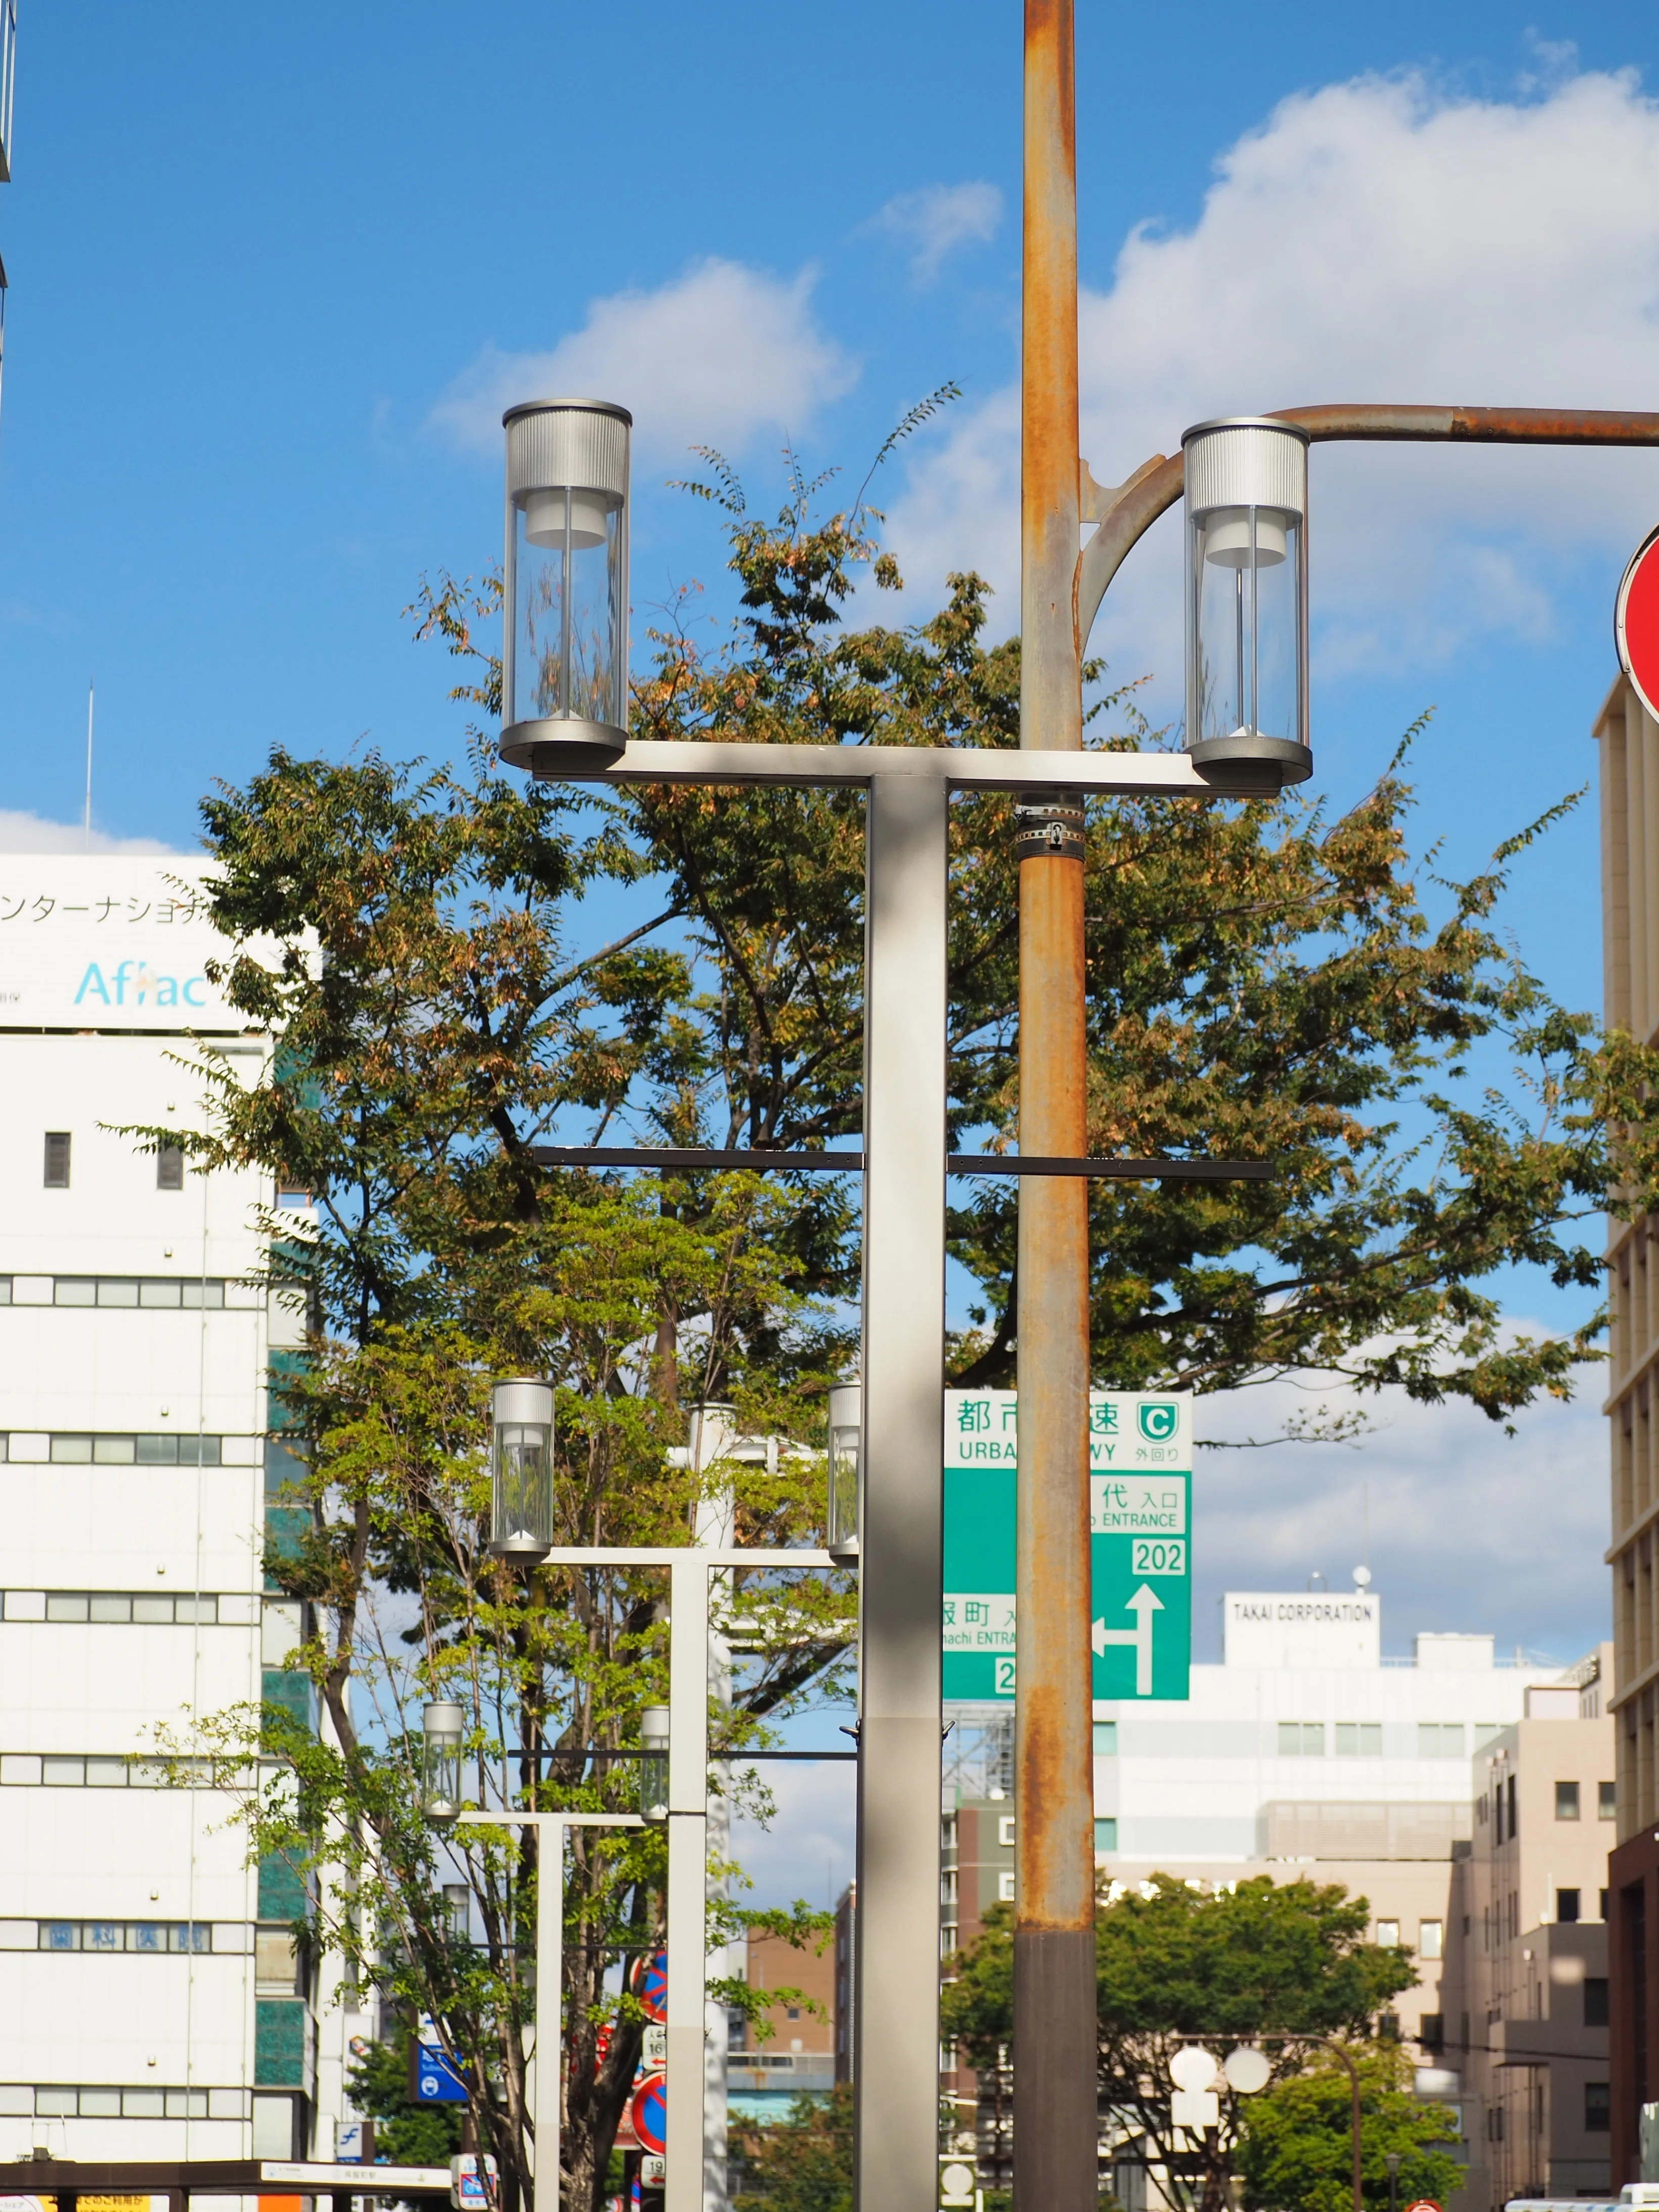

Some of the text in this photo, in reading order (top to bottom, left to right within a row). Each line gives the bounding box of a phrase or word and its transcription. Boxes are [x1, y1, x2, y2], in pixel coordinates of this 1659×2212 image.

[74, 960, 206, 1006] Aflac
[1146, 1408, 1169, 1436] C
[1136, 1447, 1178, 1461] 外回り
[1103, 1513, 1176, 1527] ENTRANCE
[1137, 1544, 1181, 1570] 202
[1234, 1604, 1372, 1621] TAKAI CORPORATION
